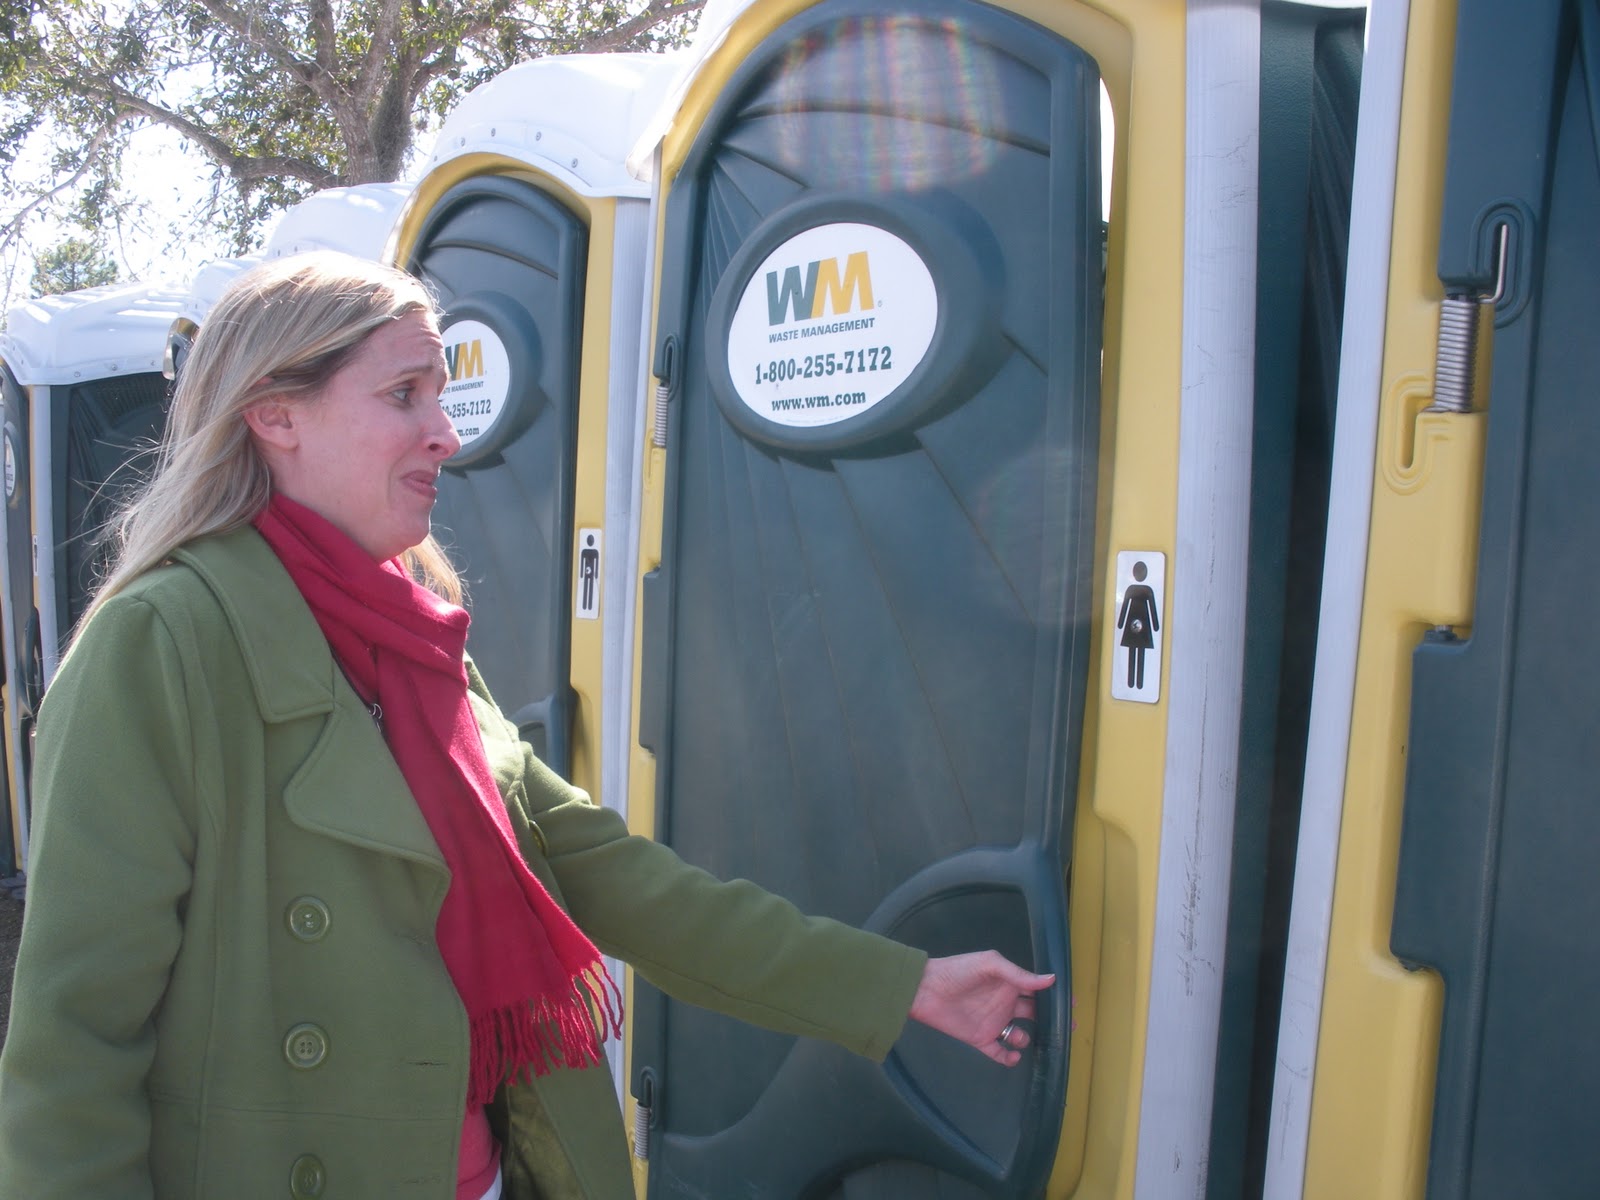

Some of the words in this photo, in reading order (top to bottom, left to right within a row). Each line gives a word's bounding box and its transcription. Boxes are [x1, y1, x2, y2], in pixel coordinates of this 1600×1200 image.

[766, 251, 874, 327] WM
[768, 329, 799, 344] WASTE
[801, 317, 875, 338] MANAGEMENT
[755, 346, 892, 385] 1-800-255-7172
[451, 381, 484, 392] MANAGEMENT
[772, 392, 866, 411] www.wm.com
